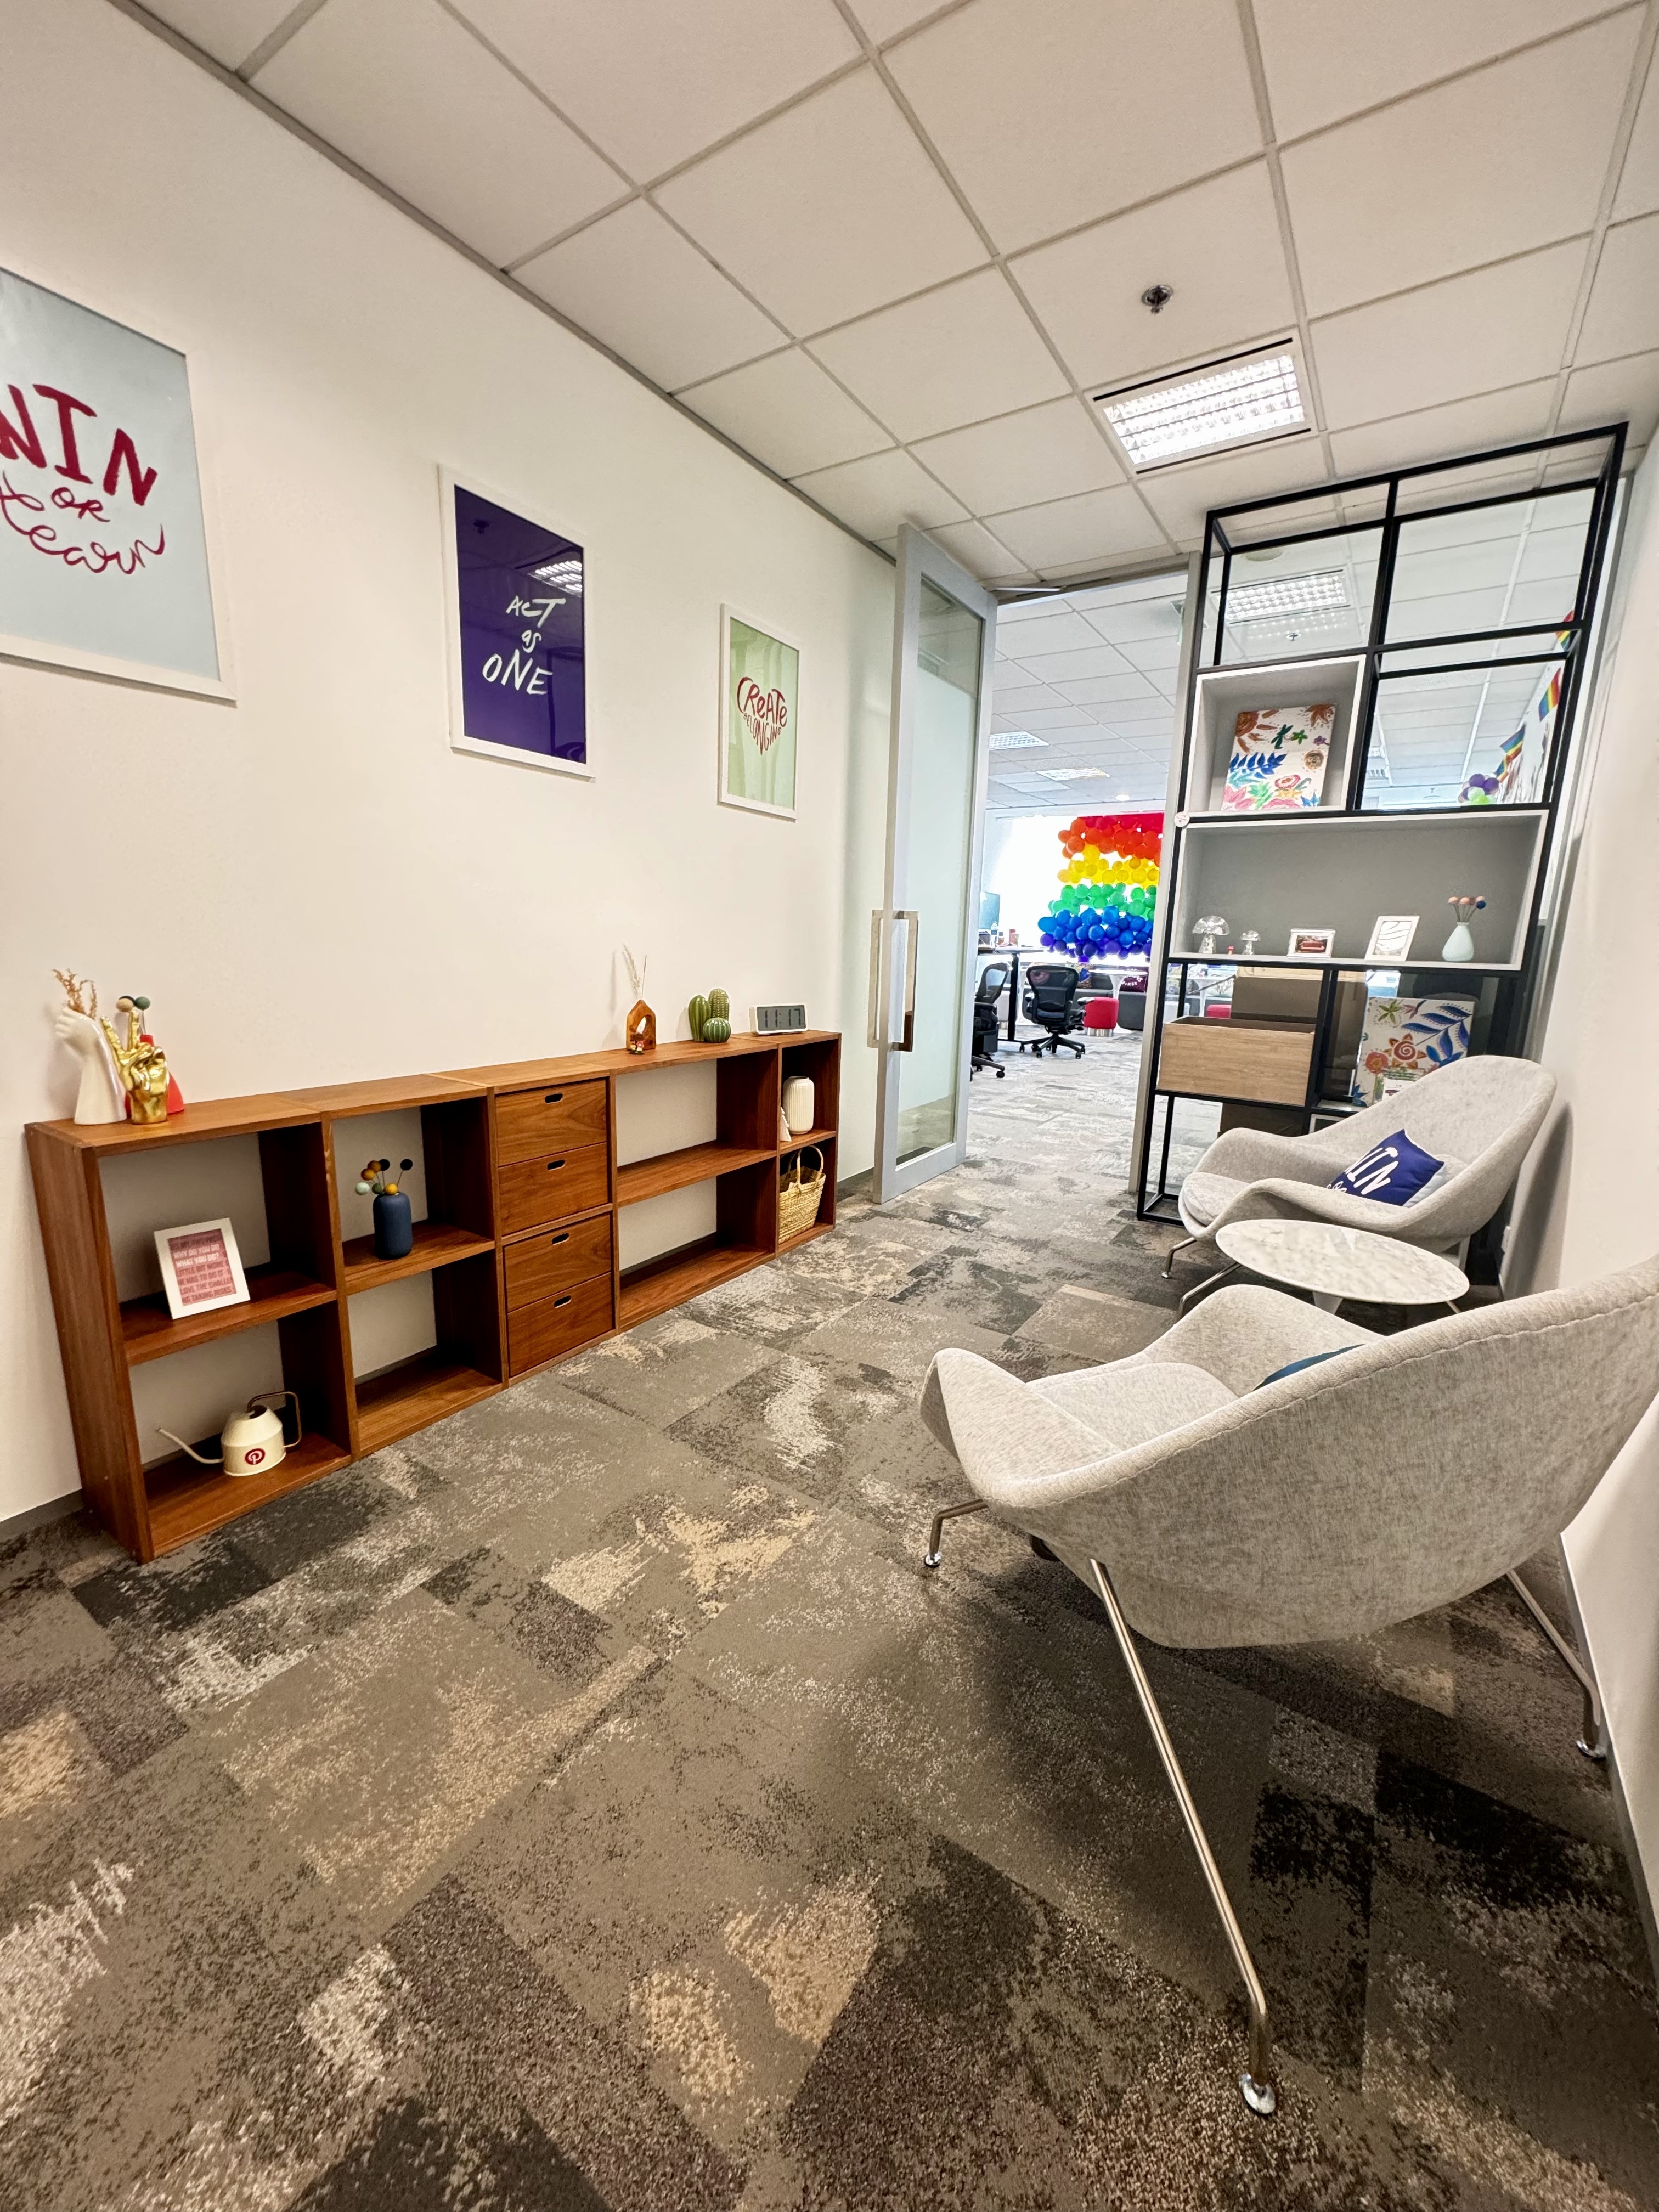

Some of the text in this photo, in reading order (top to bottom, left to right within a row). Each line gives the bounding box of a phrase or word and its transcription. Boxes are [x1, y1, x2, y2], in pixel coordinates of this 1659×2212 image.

[51, 487, 111, 522] OR
[506, 595, 566, 628] ACT
[521, 630, 542, 653] as
[482, 648, 553, 695] ONE
[743, 713, 782, 756] BELONGING
[765, 1008, 801, 1028] 11:17
[174, 1257, 194, 1268] WHAT
[193, 1255, 207, 1264] YOU
[197, 1245, 210, 1254] YOU
